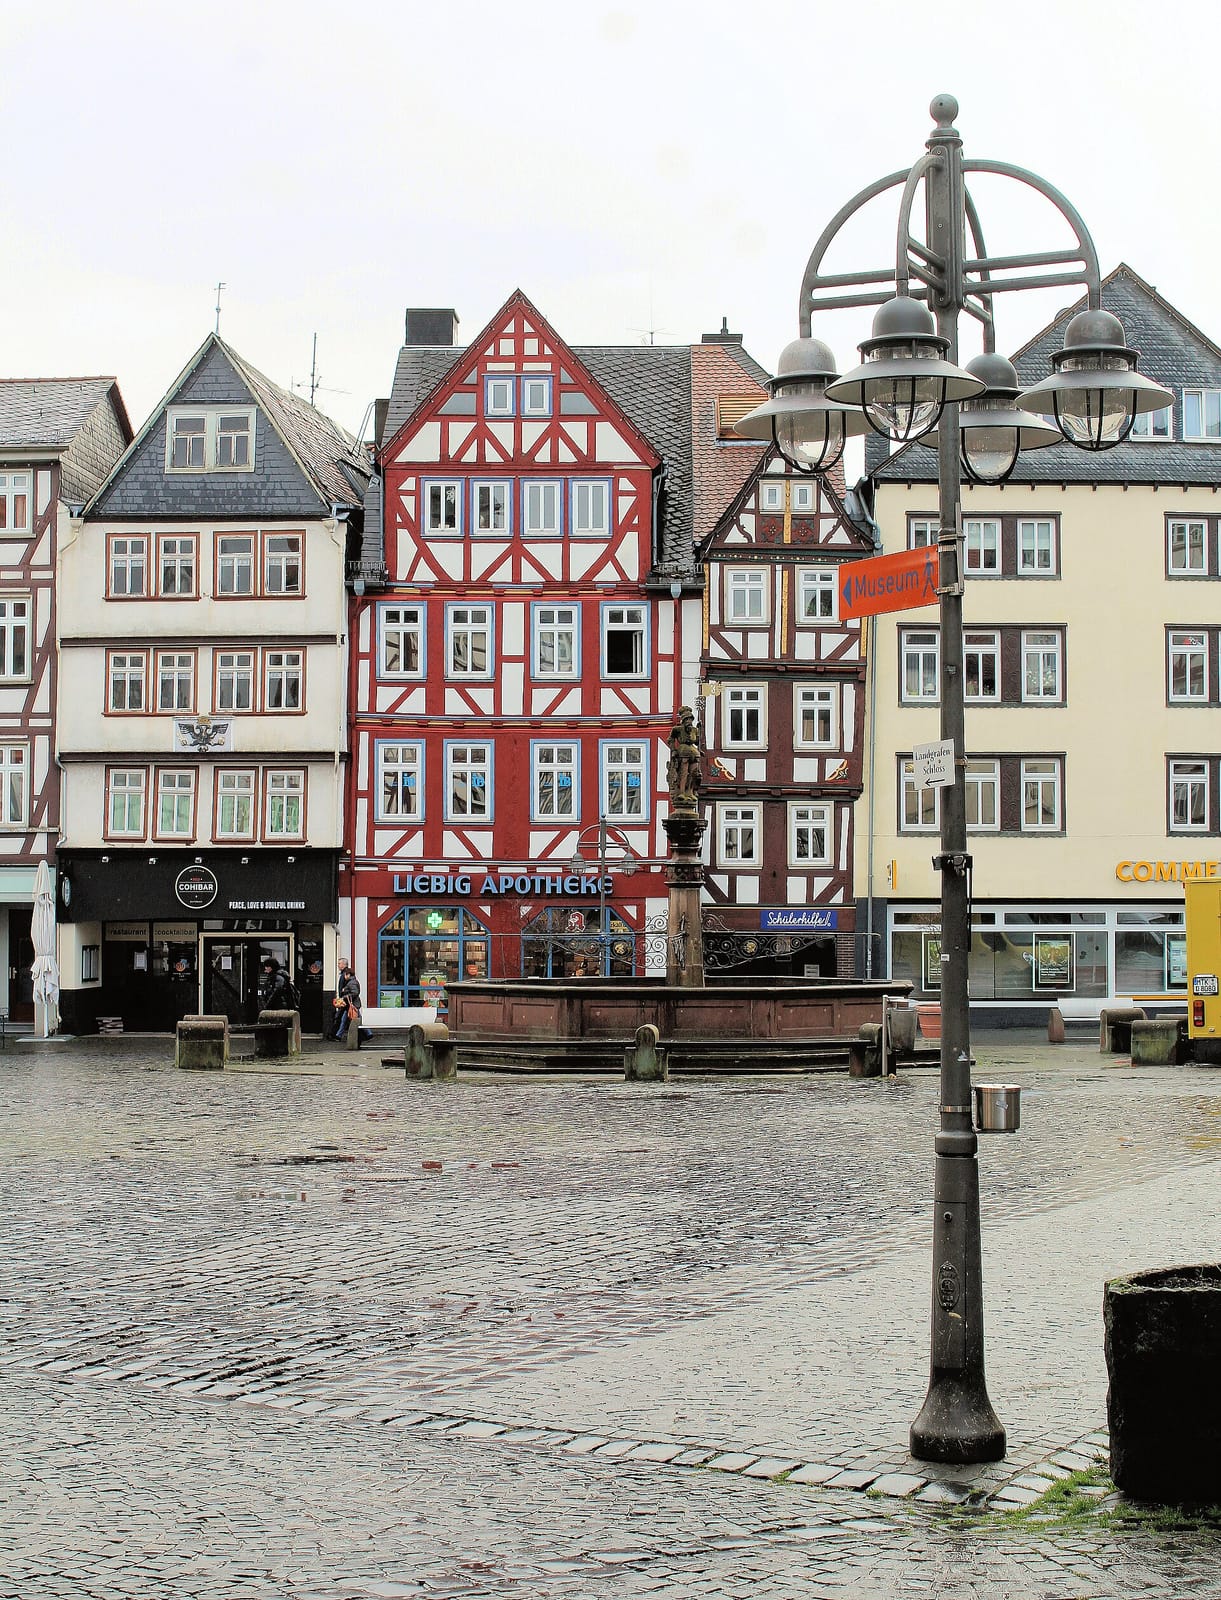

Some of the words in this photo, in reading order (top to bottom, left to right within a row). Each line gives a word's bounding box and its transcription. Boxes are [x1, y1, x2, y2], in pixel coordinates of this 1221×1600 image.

[855, 569, 919, 599] Museum
[922, 764, 946, 775] Schloss
[178, 883, 214, 891] COHIBAR
[393, 874, 471, 894] LIEBIG
[480, 875, 613, 895] APOTHEKE
[247, 901, 260, 910] LOVE
[265, 901, 287, 910] SOULFUL
[110, 927, 147, 936] restaurant
